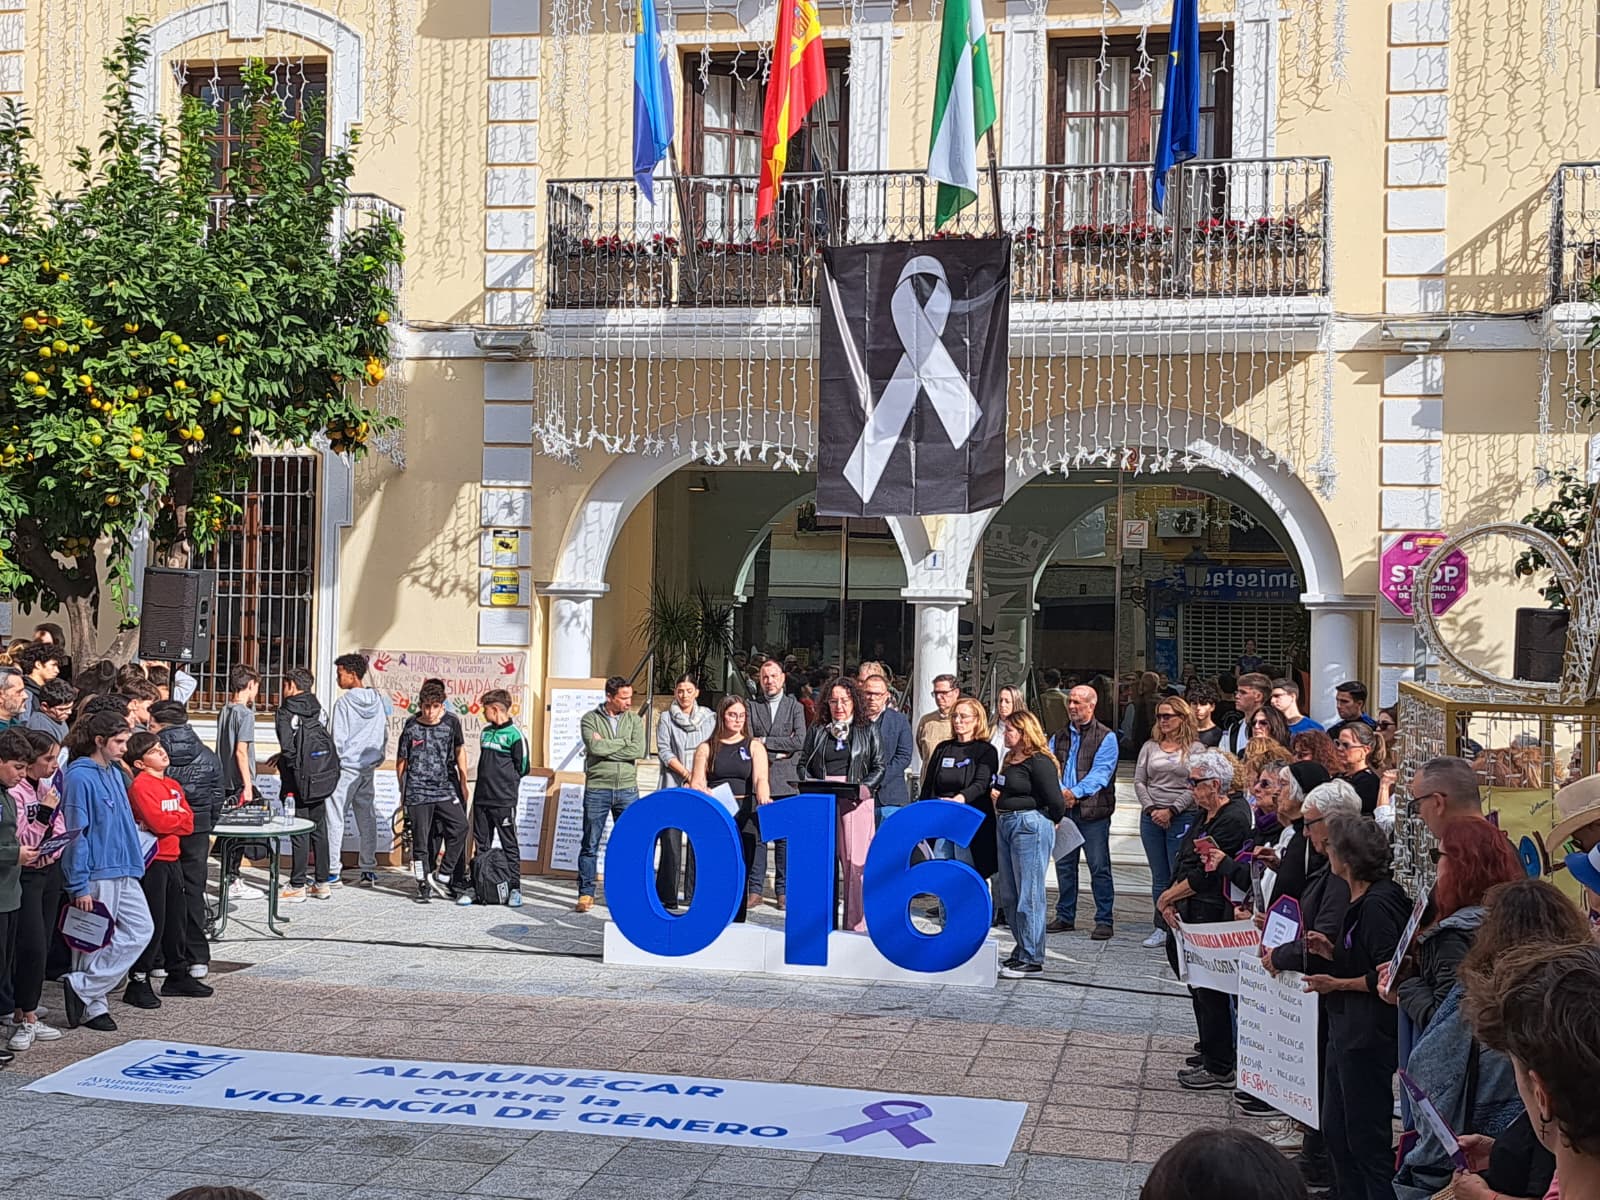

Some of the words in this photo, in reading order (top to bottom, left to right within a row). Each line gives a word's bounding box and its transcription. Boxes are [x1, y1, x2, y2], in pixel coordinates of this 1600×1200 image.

[410, 655, 440, 673] HARTAS
[456, 656, 492, 665] VIOLENCIA
[604, 787, 993, 973] 016
[1220, 930, 1260, 948] MACHISTA
[84, 1076, 192, 1089] Ayuntamiento
[353, 1066, 725, 1097] ALMUÑÉCAR
[414, 1087, 566, 1104] contra
[579, 1094, 621, 1107] la
[224, 1088, 477, 1115] VIOLENCIA
[494, 1106, 567, 1121] DE
[578, 1112, 788, 1137] GÉNERO
